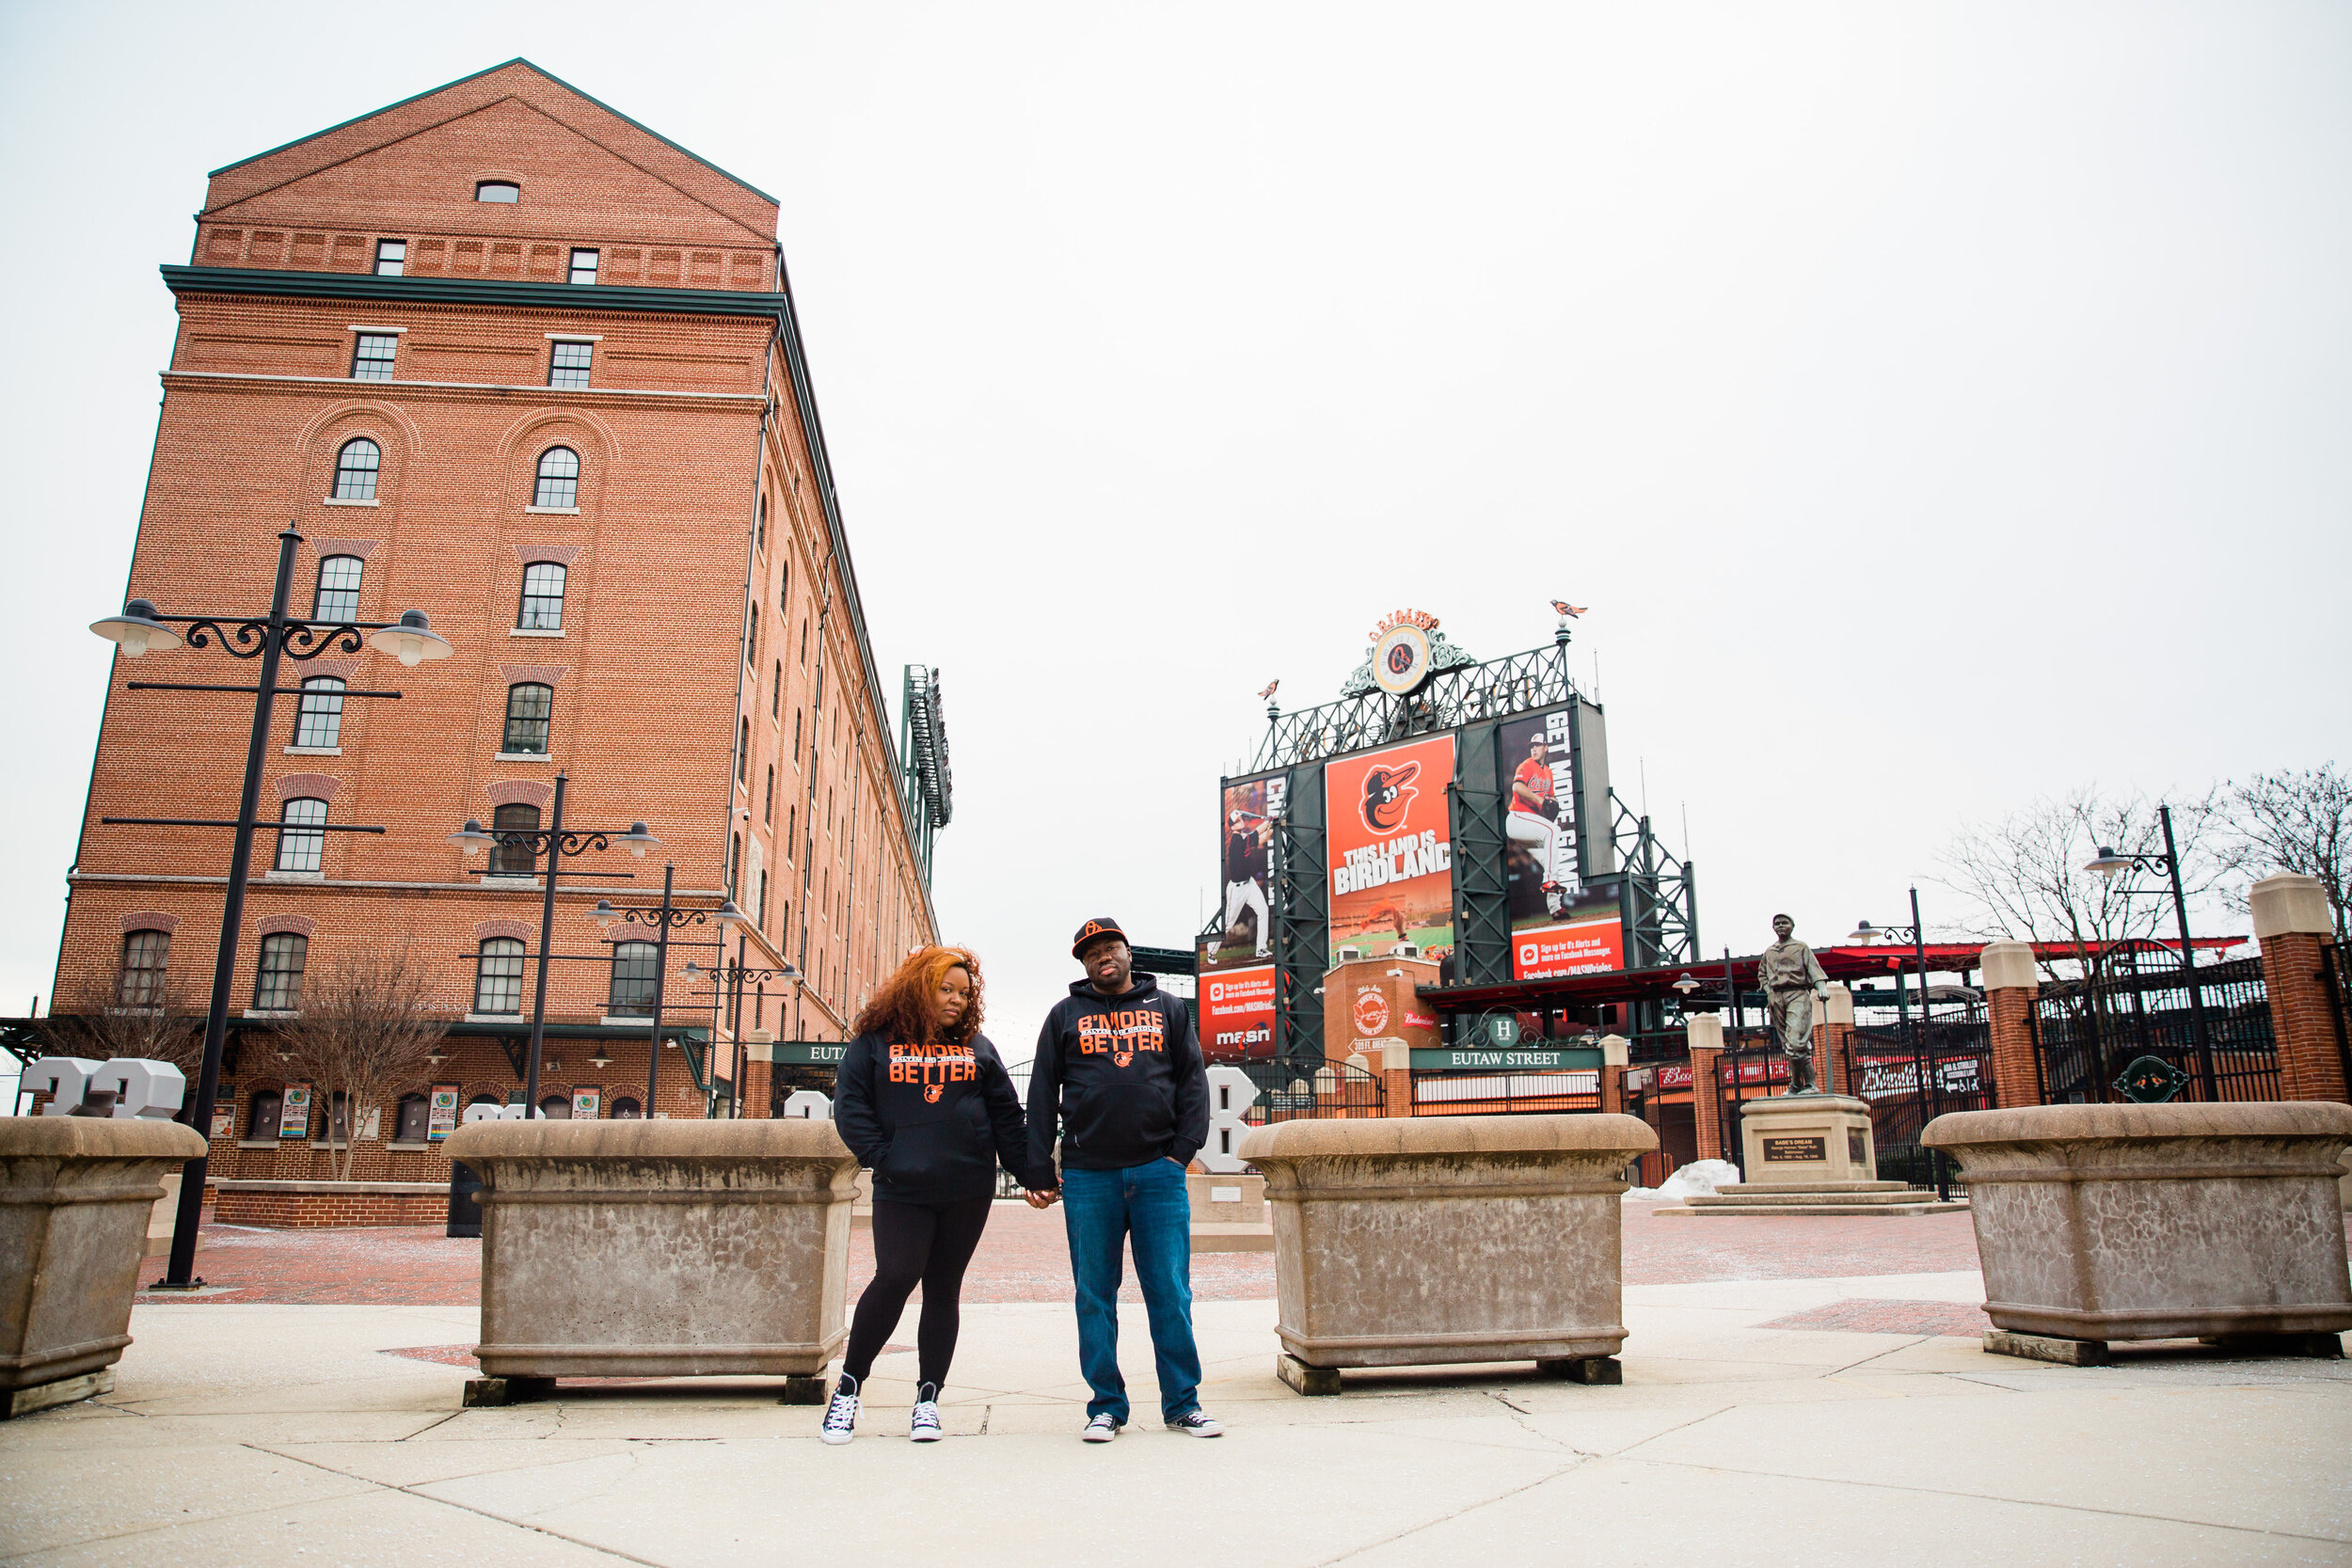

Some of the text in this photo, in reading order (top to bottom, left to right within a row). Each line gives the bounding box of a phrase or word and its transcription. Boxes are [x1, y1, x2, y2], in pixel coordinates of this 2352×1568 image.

[1546, 710, 1581, 895] GET MORE GAME
[1343, 829, 1436, 865] THIS LAND IS
[1333, 842, 1451, 896] BIRDLAND
[1540, 943, 1551, 954] Sign
[1552, 944, 1559, 953] up
[1575, 939, 1591, 949] Alerts
[1591, 937, 1600, 947] and
[1541, 954, 1553, 962] more
[1561, 950, 1582, 960] Facebook
[1078, 1010, 1164, 1032] B'MORE
[1405, 1012, 1435, 1026] Budweiser
[1216, 1029, 1270, 1045] masn
[1496, 1021, 1511, 1037] H
[1079, 1032, 1165, 1054] BETTER
[889, 1044, 976, 1060] B'MORE
[1452, 1052, 1560, 1066] EUTAW STREET
[889, 1061, 977, 1084] BETTER
[1952, 1063, 1958, 1071] &
[1957, 1059, 1979, 1070] STROLLER
